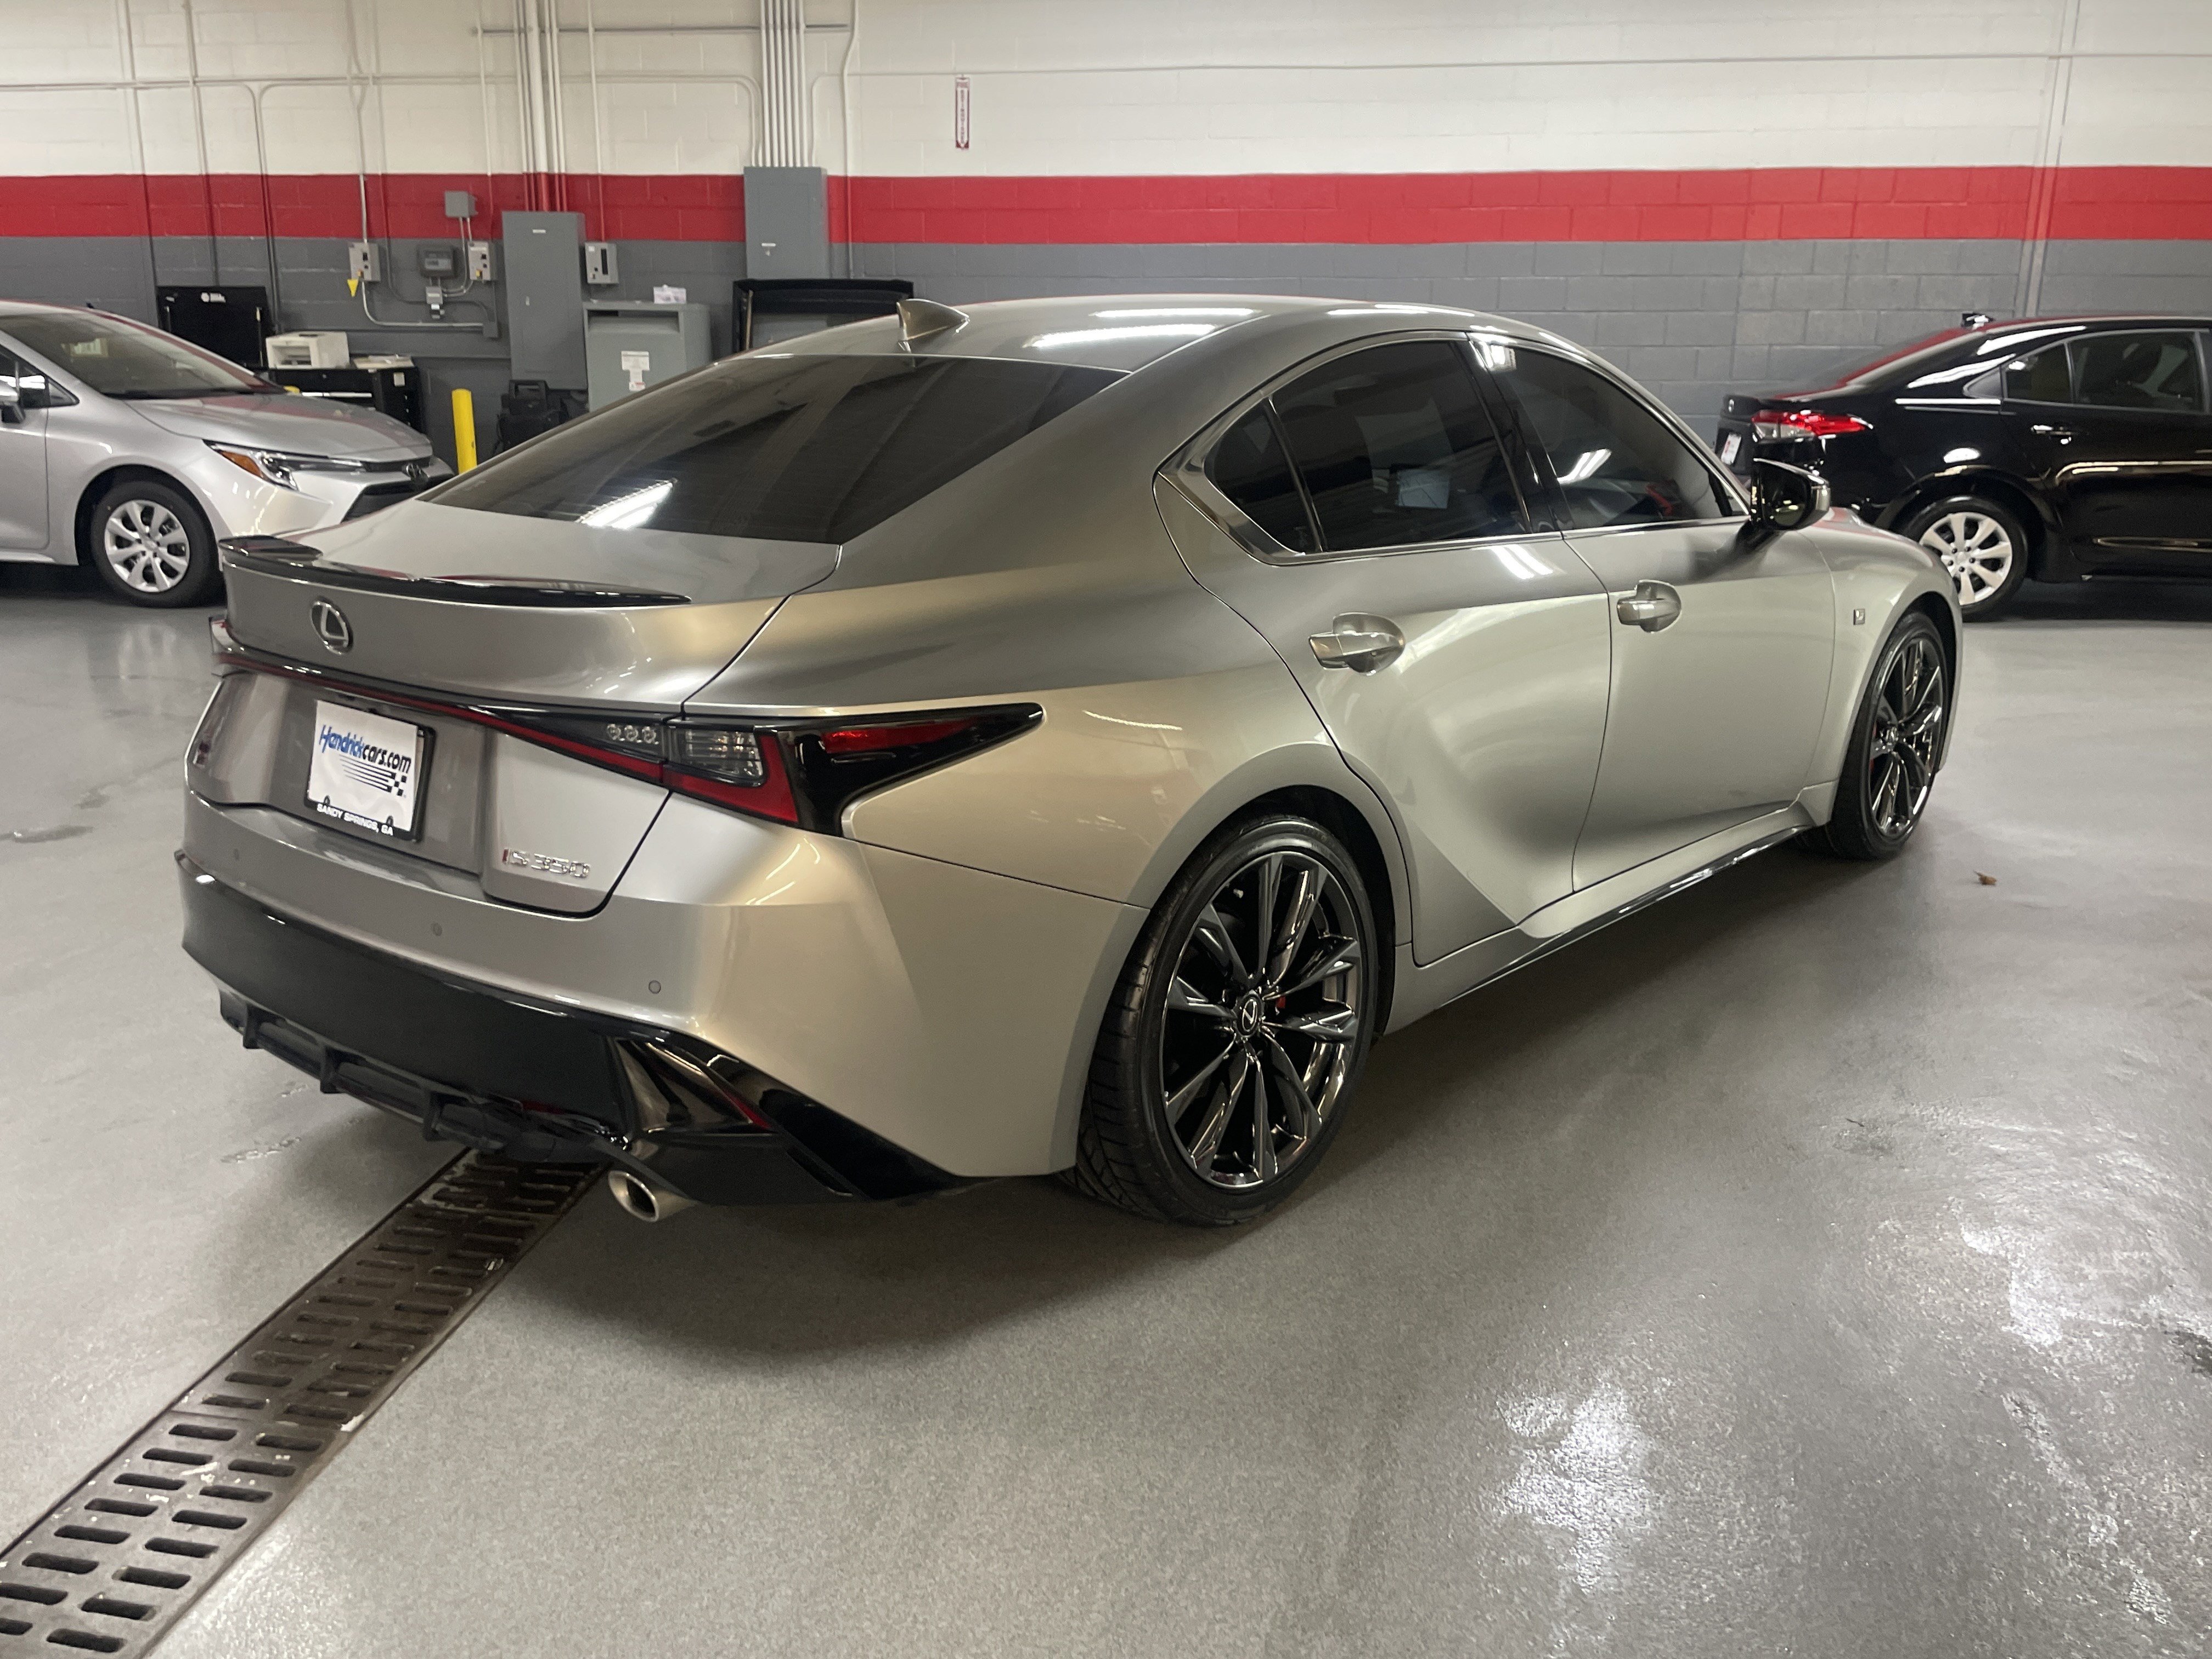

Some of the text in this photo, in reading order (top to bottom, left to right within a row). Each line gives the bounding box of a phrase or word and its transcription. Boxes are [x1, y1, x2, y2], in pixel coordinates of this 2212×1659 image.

[319, 724, 411, 774] Hendrickcars.com
[317, 803, 343, 819] SANDY
[381, 824, 394, 836] GA
